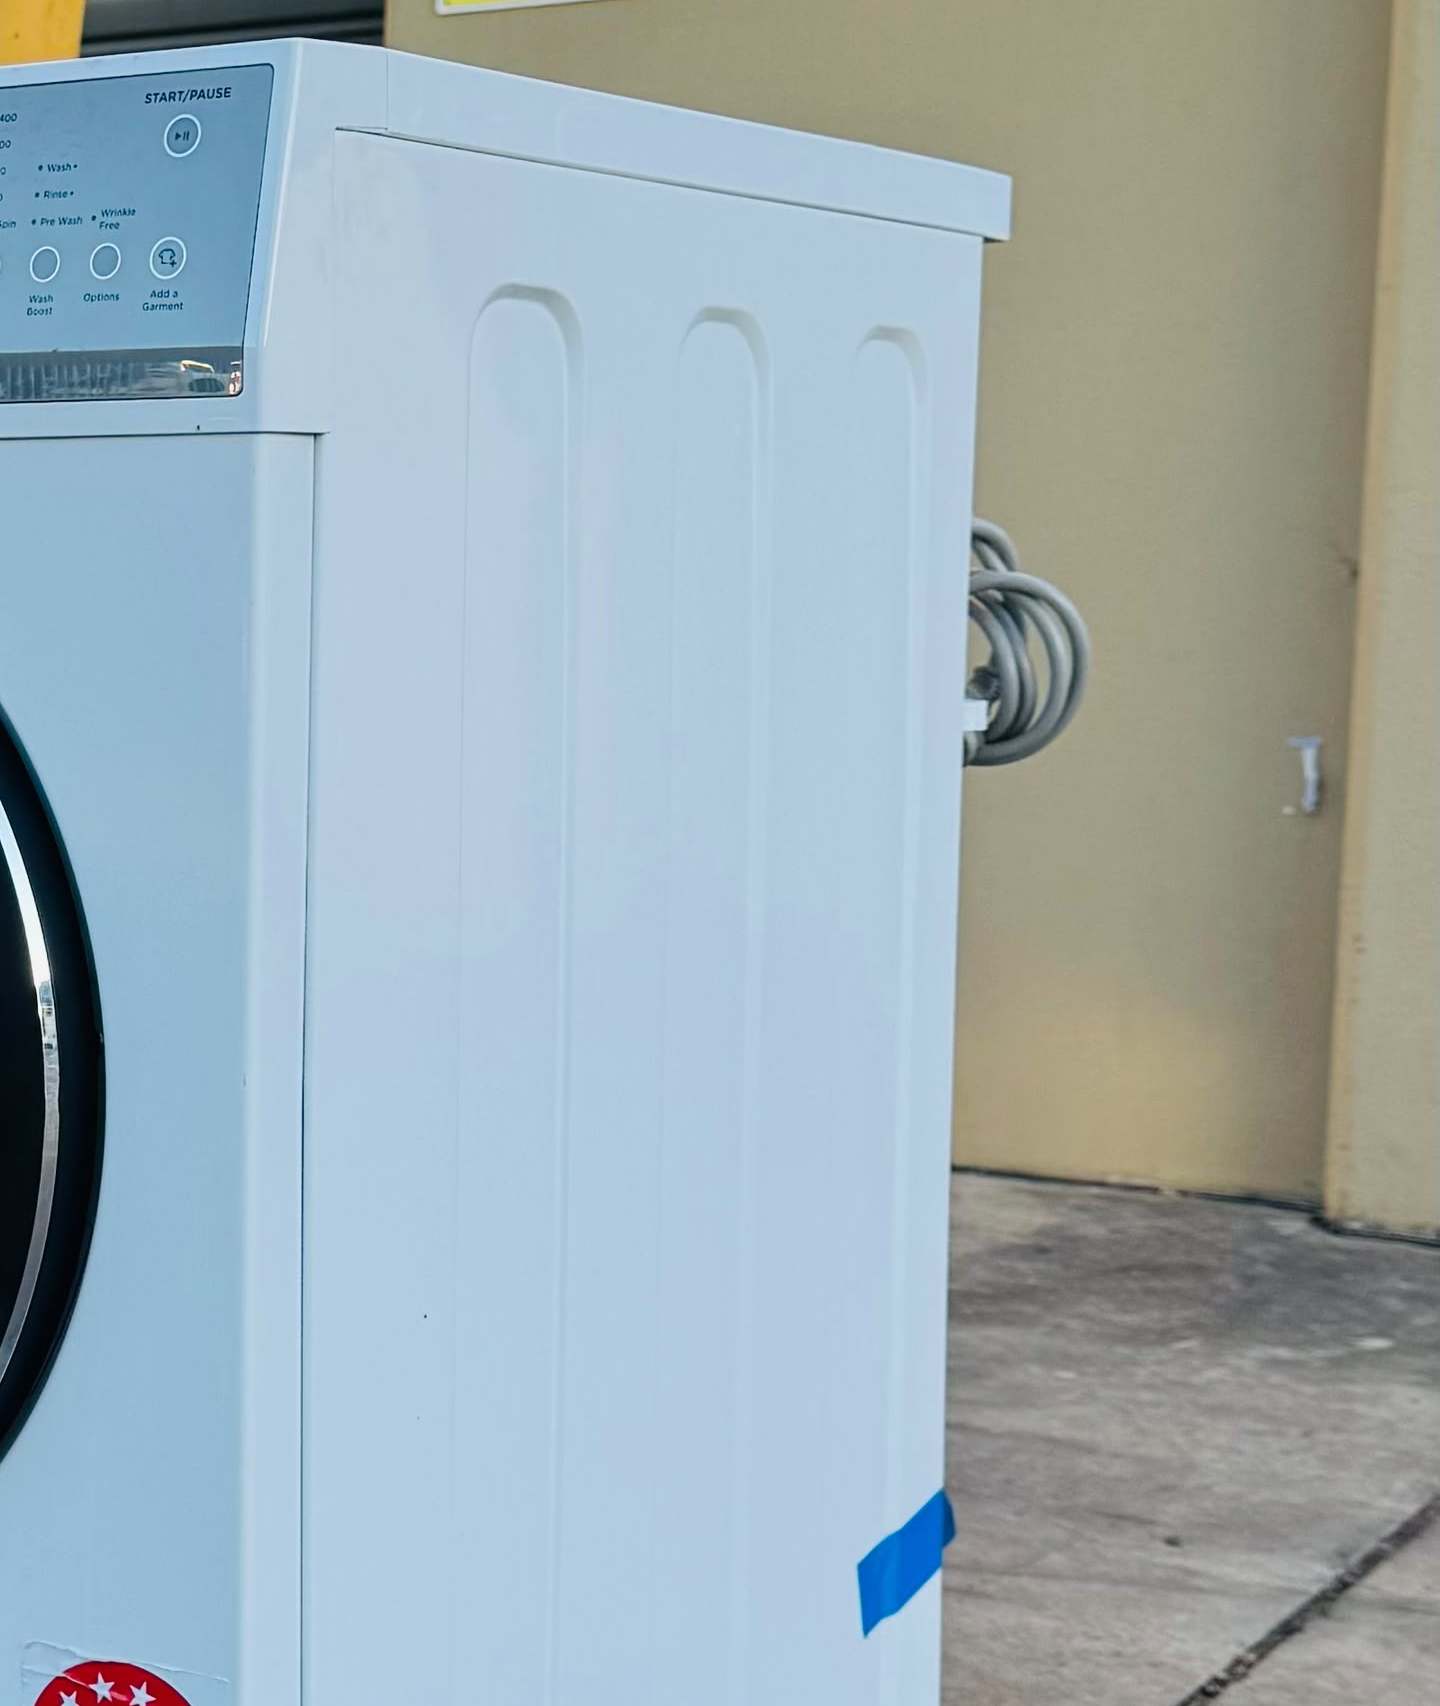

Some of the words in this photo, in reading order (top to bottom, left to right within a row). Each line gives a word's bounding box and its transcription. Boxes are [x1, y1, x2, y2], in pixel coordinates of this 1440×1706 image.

[144, 87, 232, 104] START/PAUSE
[101, 207, 136, 218] Wrinkle
[40, 217, 55, 227] Pre
[58, 216, 83, 226] Wash
[99, 221, 120, 230] Free
[29, 294, 53, 304] Wash
[83, 293, 120, 303] Options
[149, 290, 169, 299] Add
[142, 302, 183, 312] Garment
